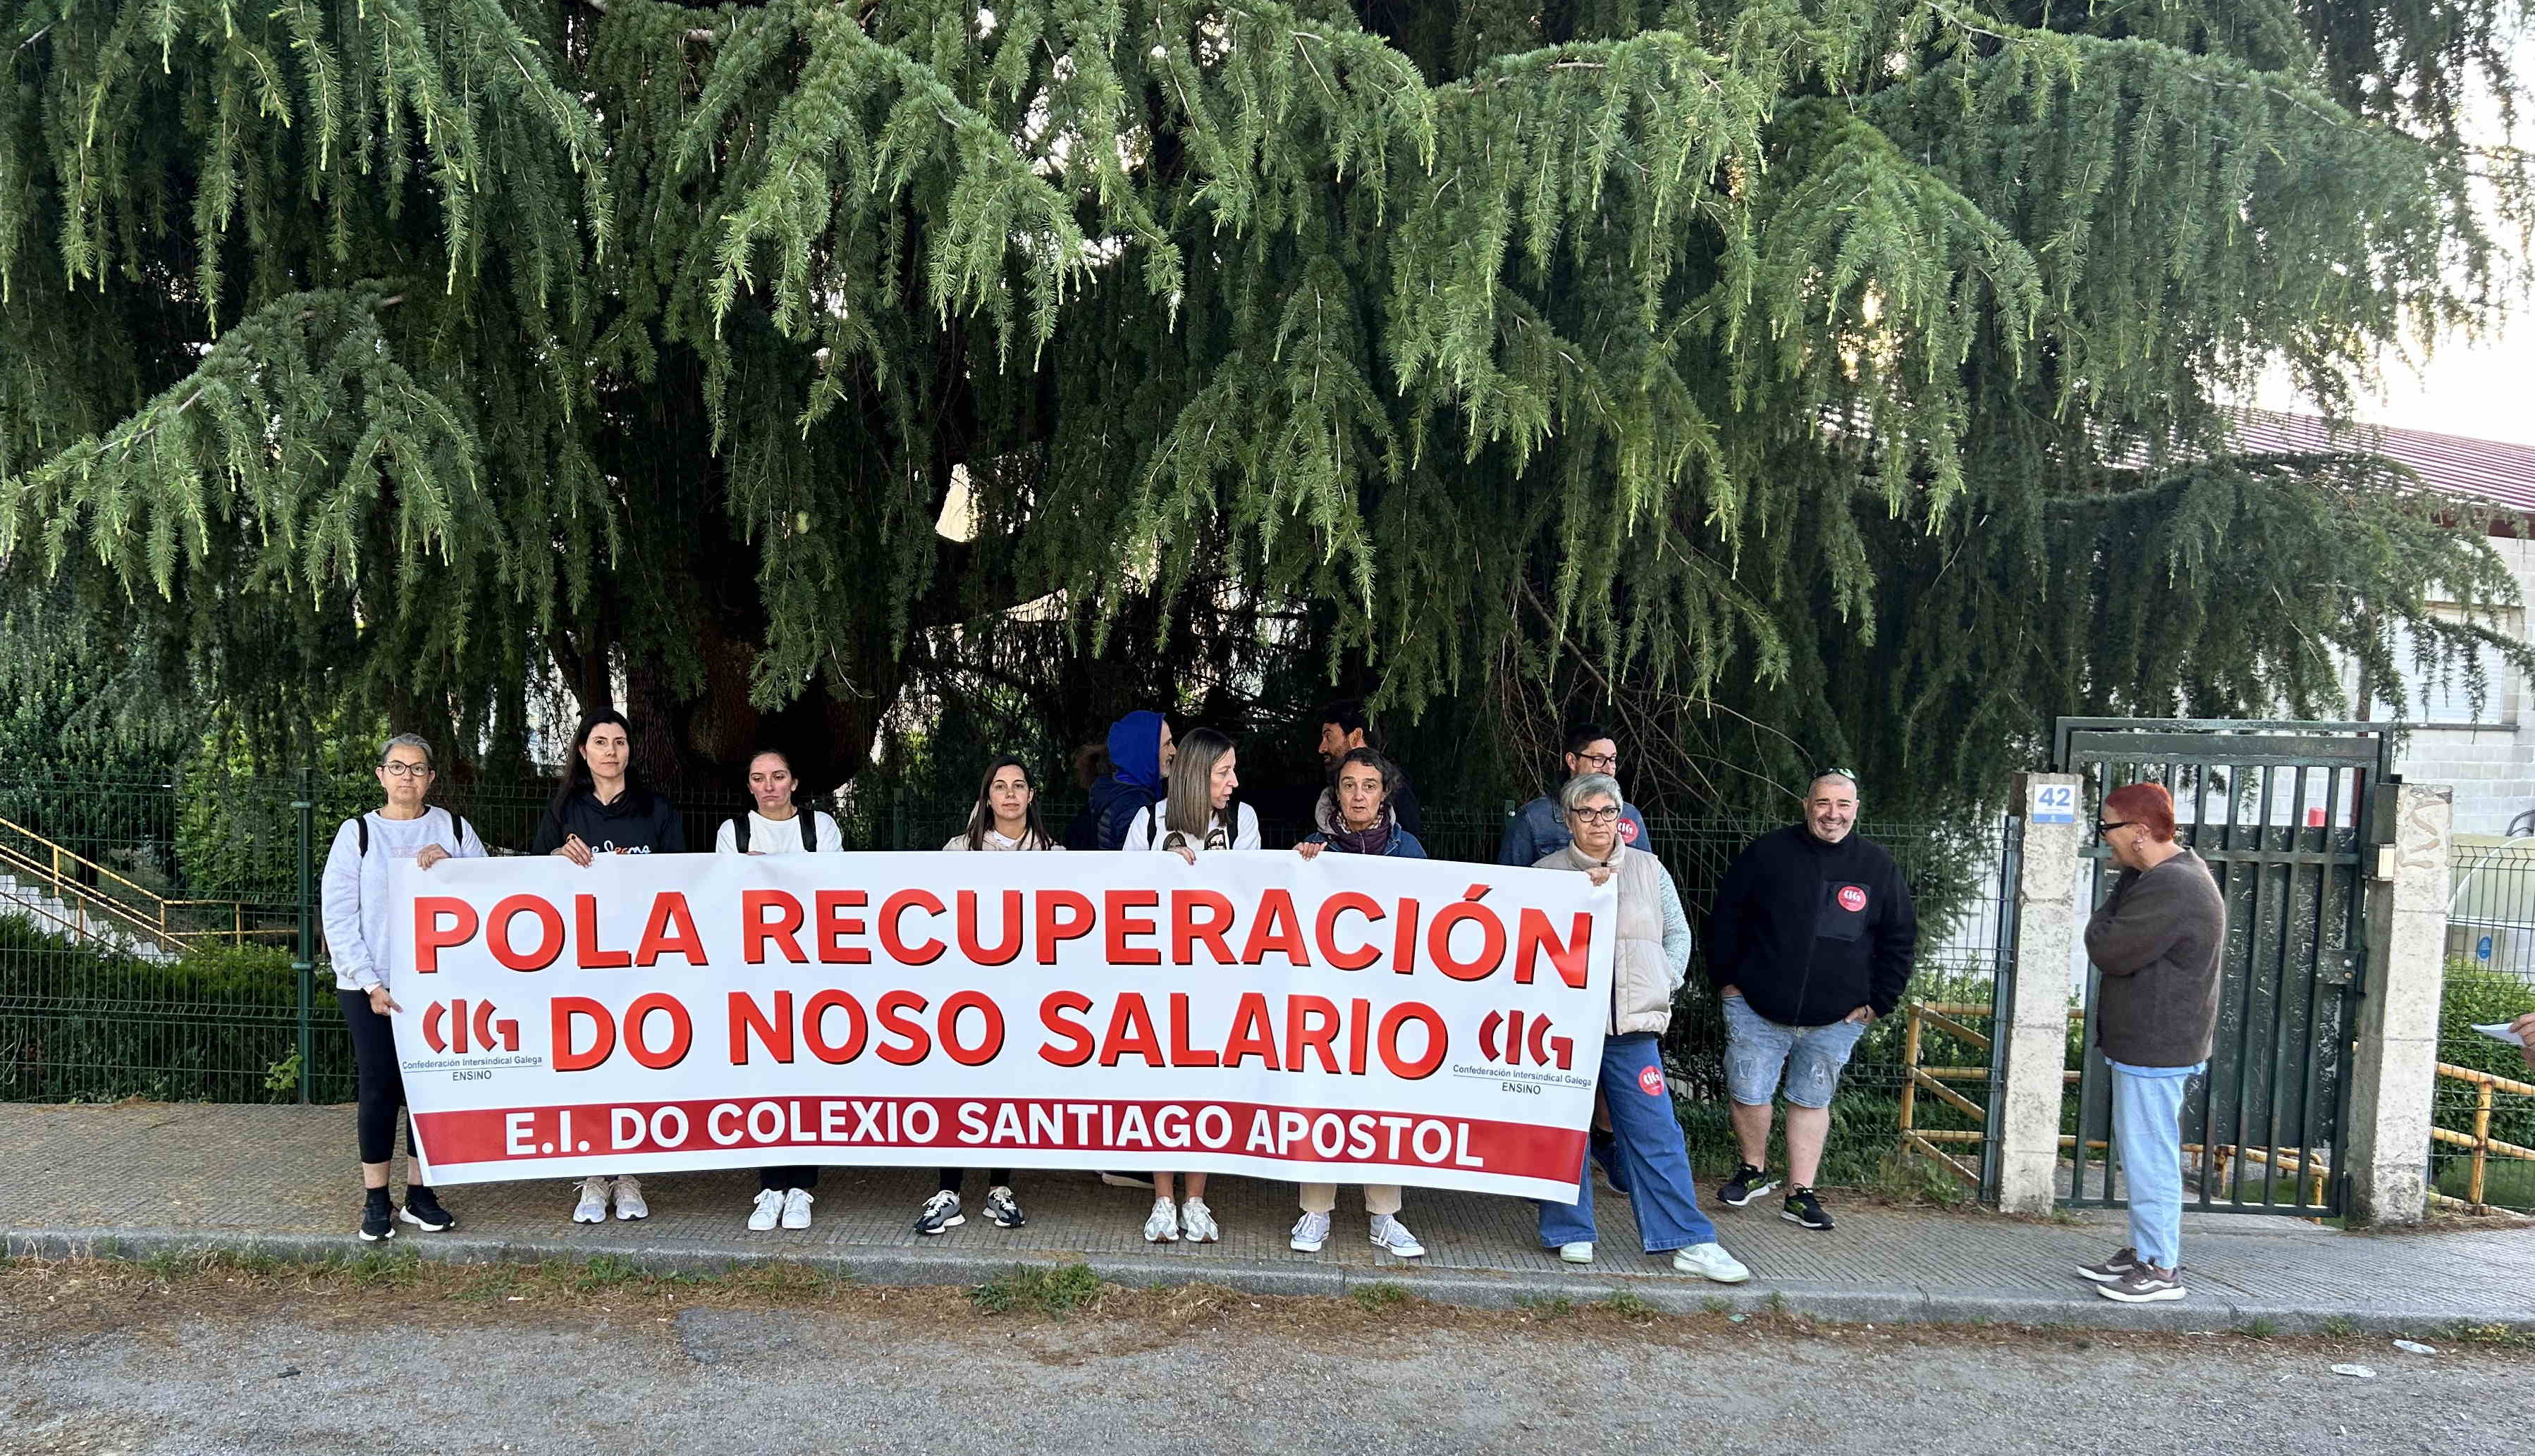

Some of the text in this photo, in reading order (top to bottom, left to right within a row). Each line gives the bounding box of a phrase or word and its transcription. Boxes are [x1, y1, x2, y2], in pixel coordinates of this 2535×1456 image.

[2038, 787, 2070, 807] 42
[414, 884, 1593, 989] POLA RECUPERACIÓN
[422, 998, 520, 1054] CIG
[551, 989, 1449, 1080] DO NOSO SALARIO
[1478, 1009, 1573, 1071] CIG
[402, 1056, 541, 1070] Confederación Intersindical Galega
[452, 1070, 492, 1081] ENSINO
[1453, 1064, 1592, 1087] Confederación Intersindical Galega
[1502, 1082, 1541, 1094] ENSINO
[505, 1101, 1484, 1168] E.I. DO COLEXIO SANTIAGO APOSTOL
